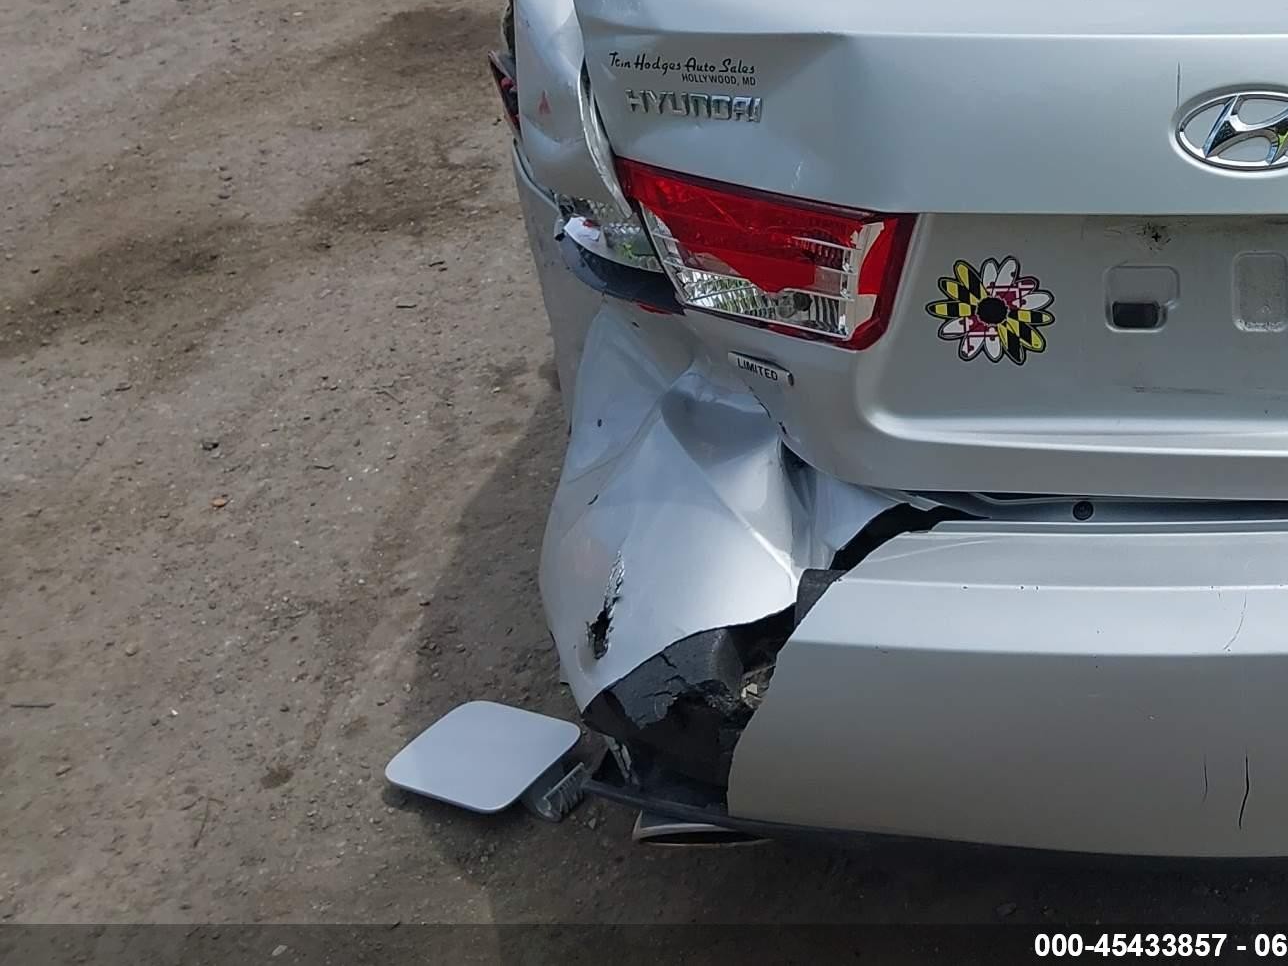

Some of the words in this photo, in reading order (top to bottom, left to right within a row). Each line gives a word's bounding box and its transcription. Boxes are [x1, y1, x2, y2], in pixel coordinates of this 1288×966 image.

[634, 54, 681, 75] Hodges
[685, 57, 716, 72] Auto
[719, 58, 755, 74] Sales
[682, 73, 739, 86] HOLLYWOOD,
[742, 77, 756, 86] MD
[625, 89, 763, 123] HYUNDAI
[737, 357, 778, 381] LIMITED
